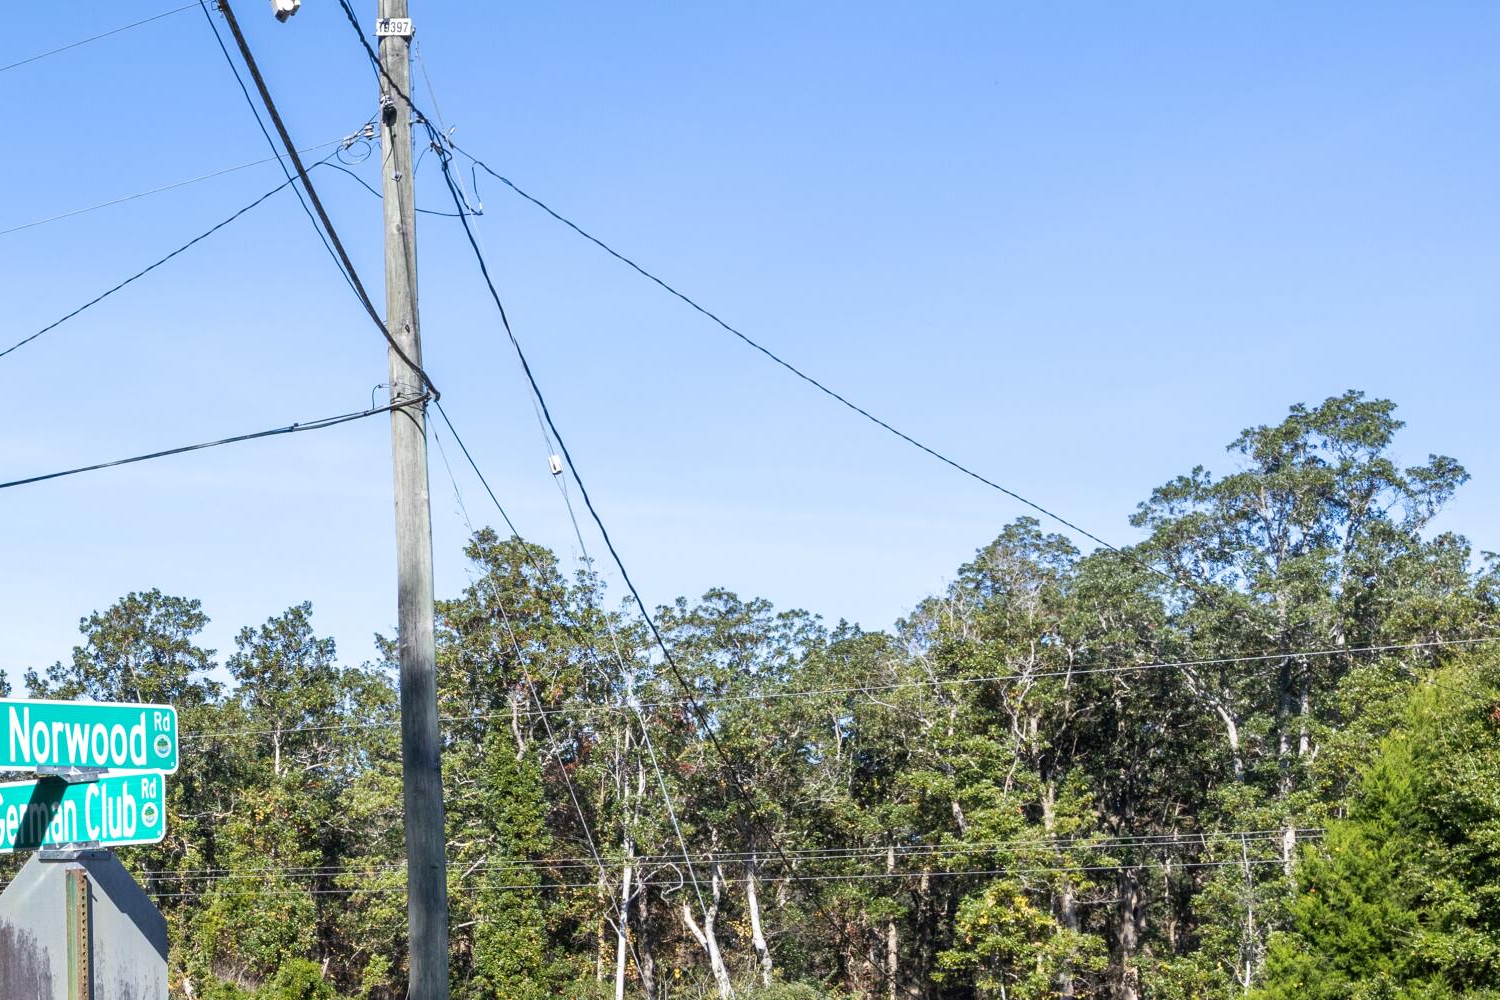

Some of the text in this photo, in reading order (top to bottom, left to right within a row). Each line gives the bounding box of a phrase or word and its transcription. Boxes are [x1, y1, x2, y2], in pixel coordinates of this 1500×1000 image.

[8, 706, 147, 766] Norwood
[153, 711, 171, 731] Rd
[85, 781, 137, 842] Club
[141, 777, 157, 799] Rd
